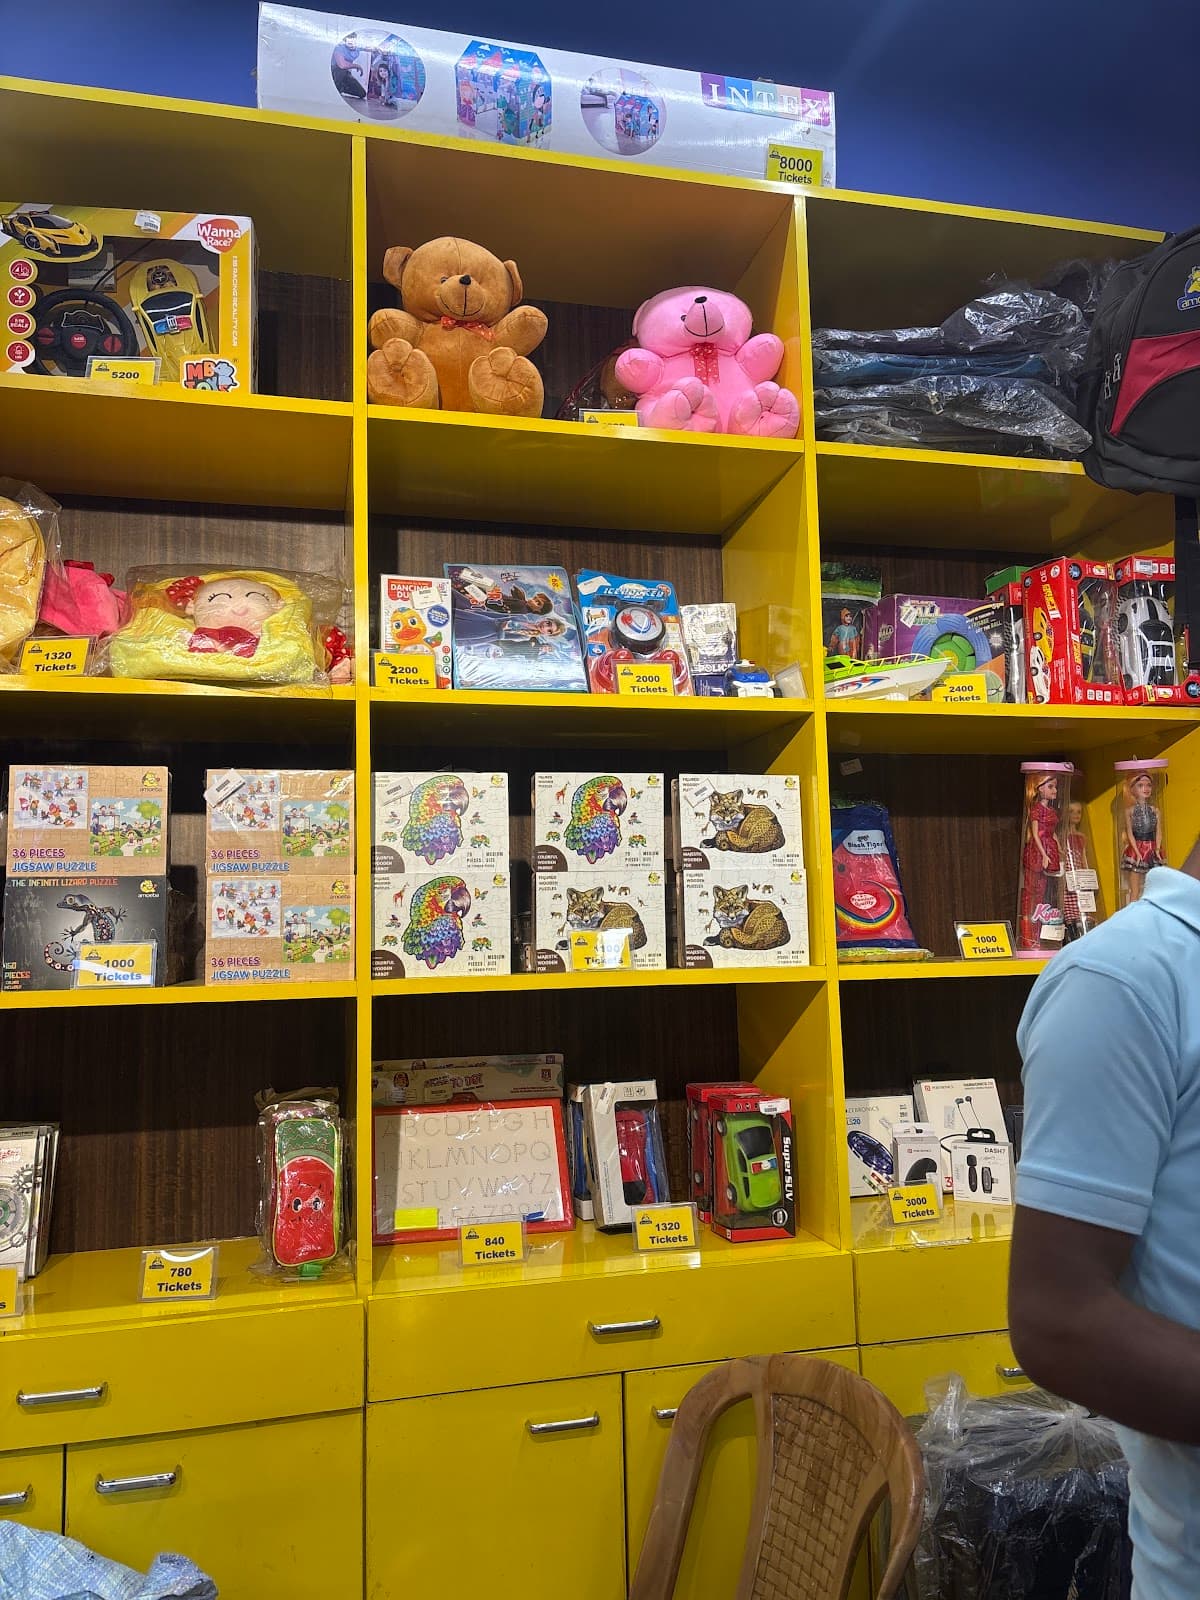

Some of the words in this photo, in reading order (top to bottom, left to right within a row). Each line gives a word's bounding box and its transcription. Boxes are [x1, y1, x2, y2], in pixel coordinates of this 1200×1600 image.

[709, 84, 822, 119] INTEX
[780, 156, 813, 172] 8000
[778, 171, 812, 184] Tickets
[197, 223, 241, 238] Wanna
[207, 237, 233, 246] Race?
[111, 371, 140, 380] 5200
[186, 361, 215, 380] MB
[44, 651, 72, 661] 1320
[34, 663, 77, 672] Tickets
[390, 665, 418, 675] 2200
[388, 676, 430, 685] Tickets
[636, 675, 660, 683] 2000
[949, 685, 974, 693] 2400
[12, 848, 27, 858] 36
[29, 848, 66, 858] PIECES
[211, 850, 224, 859] 36
[226, 850, 260, 859] PIECES
[12, 862, 54, 872] JIGSAW
[56, 861, 97, 872] PUZZLE
[211, 863, 250, 872] JIGSAW
[252, 862, 290, 872] PUZZLE
[12, 879, 26, 887] THE
[28, 879, 59, 887] INFINITI
[61, 878, 88, 886] LIZARD
[89, 878, 119, 886] PUZZLE
[973, 946, 1006, 955] Tickets
[104, 959, 135, 968] 1000
[211, 958, 225, 967] 36
[227, 957, 261, 967] PIECES
[95, 972, 142, 982] Tickets
[211, 970, 250, 980] JIGSAW
[252, 969, 291, 979] PUZZLE
[783, 1136, 793, 1174] Super
[785, 1175, 794, 1202] SUV
[906, 1197, 927, 1206] 3000
[902, 1209, 935, 1219] Tickets
[655, 1222, 680, 1231] 1320
[485, 1237, 505, 1246] 840
[649, 1234, 689, 1245] Tickets
[475, 1249, 516, 1260] Tickets
[170, 1267, 192, 1277] 780
[157, 1281, 202, 1292] Tickets
